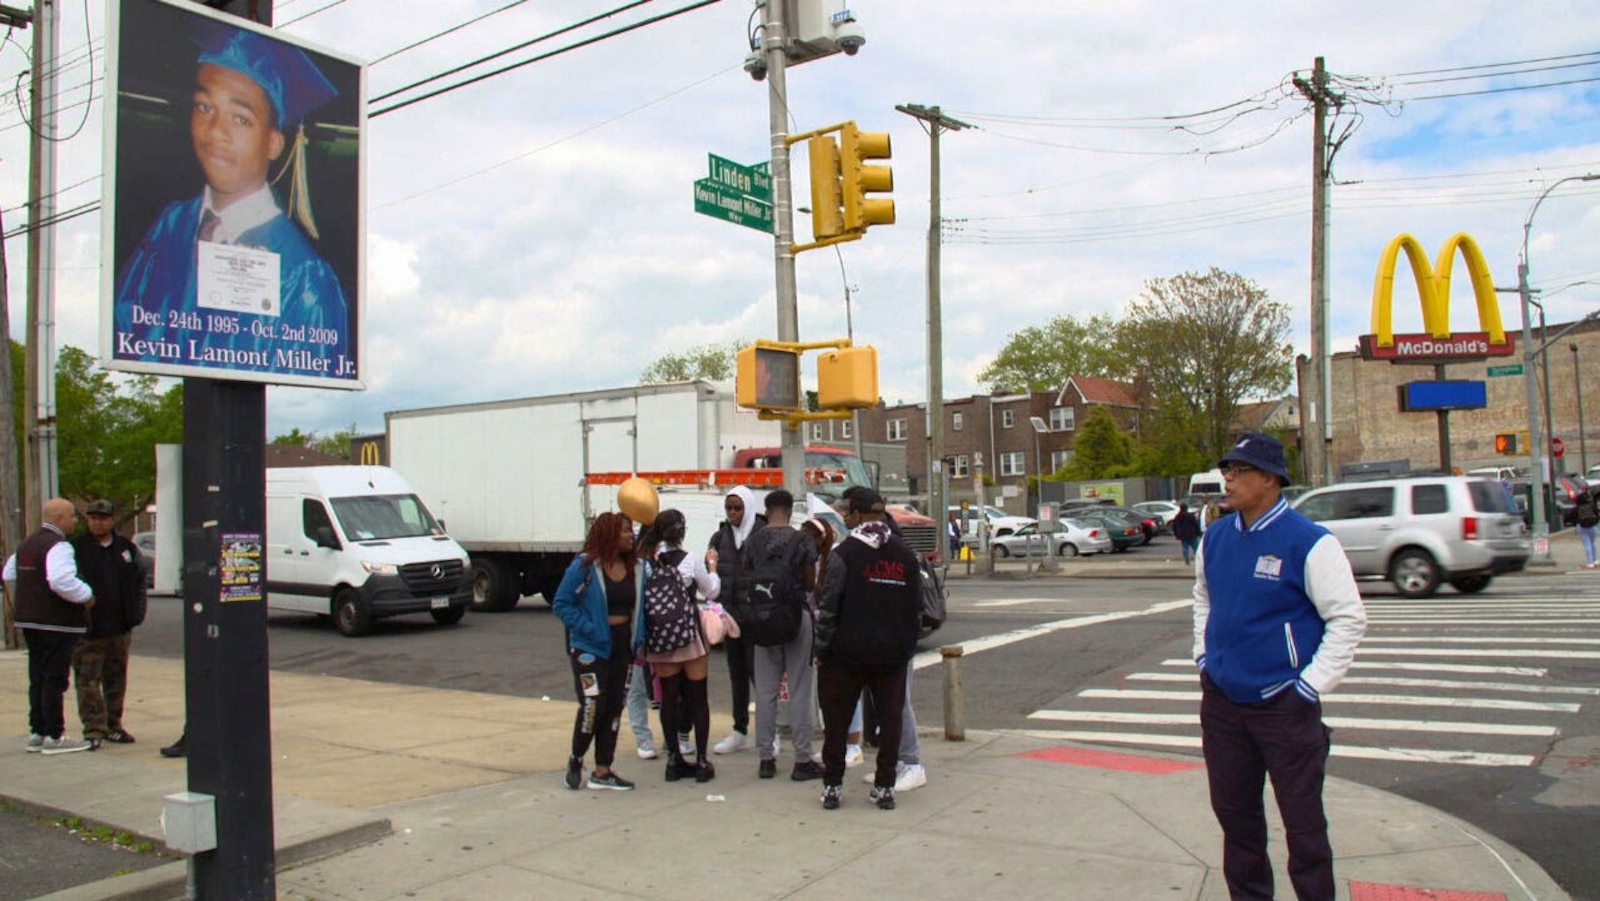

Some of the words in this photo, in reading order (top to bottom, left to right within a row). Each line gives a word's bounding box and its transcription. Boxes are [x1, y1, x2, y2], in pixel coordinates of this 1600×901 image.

[712, 157, 751, 193] Linden
[695, 184, 717, 205] Kevin
[717, 191, 743, 213] Lamont
[743, 199, 762, 219] Miller
[131, 305, 165, 328] Dec.
[169, 308, 202, 331] 24th
[206, 314, 239, 334] 1995
[251, 318, 278, 339] Oct.
[281, 322, 306, 342] 2nd
[309, 326, 338, 346] 2009
[117, 331, 182, 359] Kevin
[188, 340, 269, 367] Lamont
[275, 347, 331, 374] Miller
[335, 355, 357, 376] Jr.
[1398, 340, 1488, 355] McDonald's
